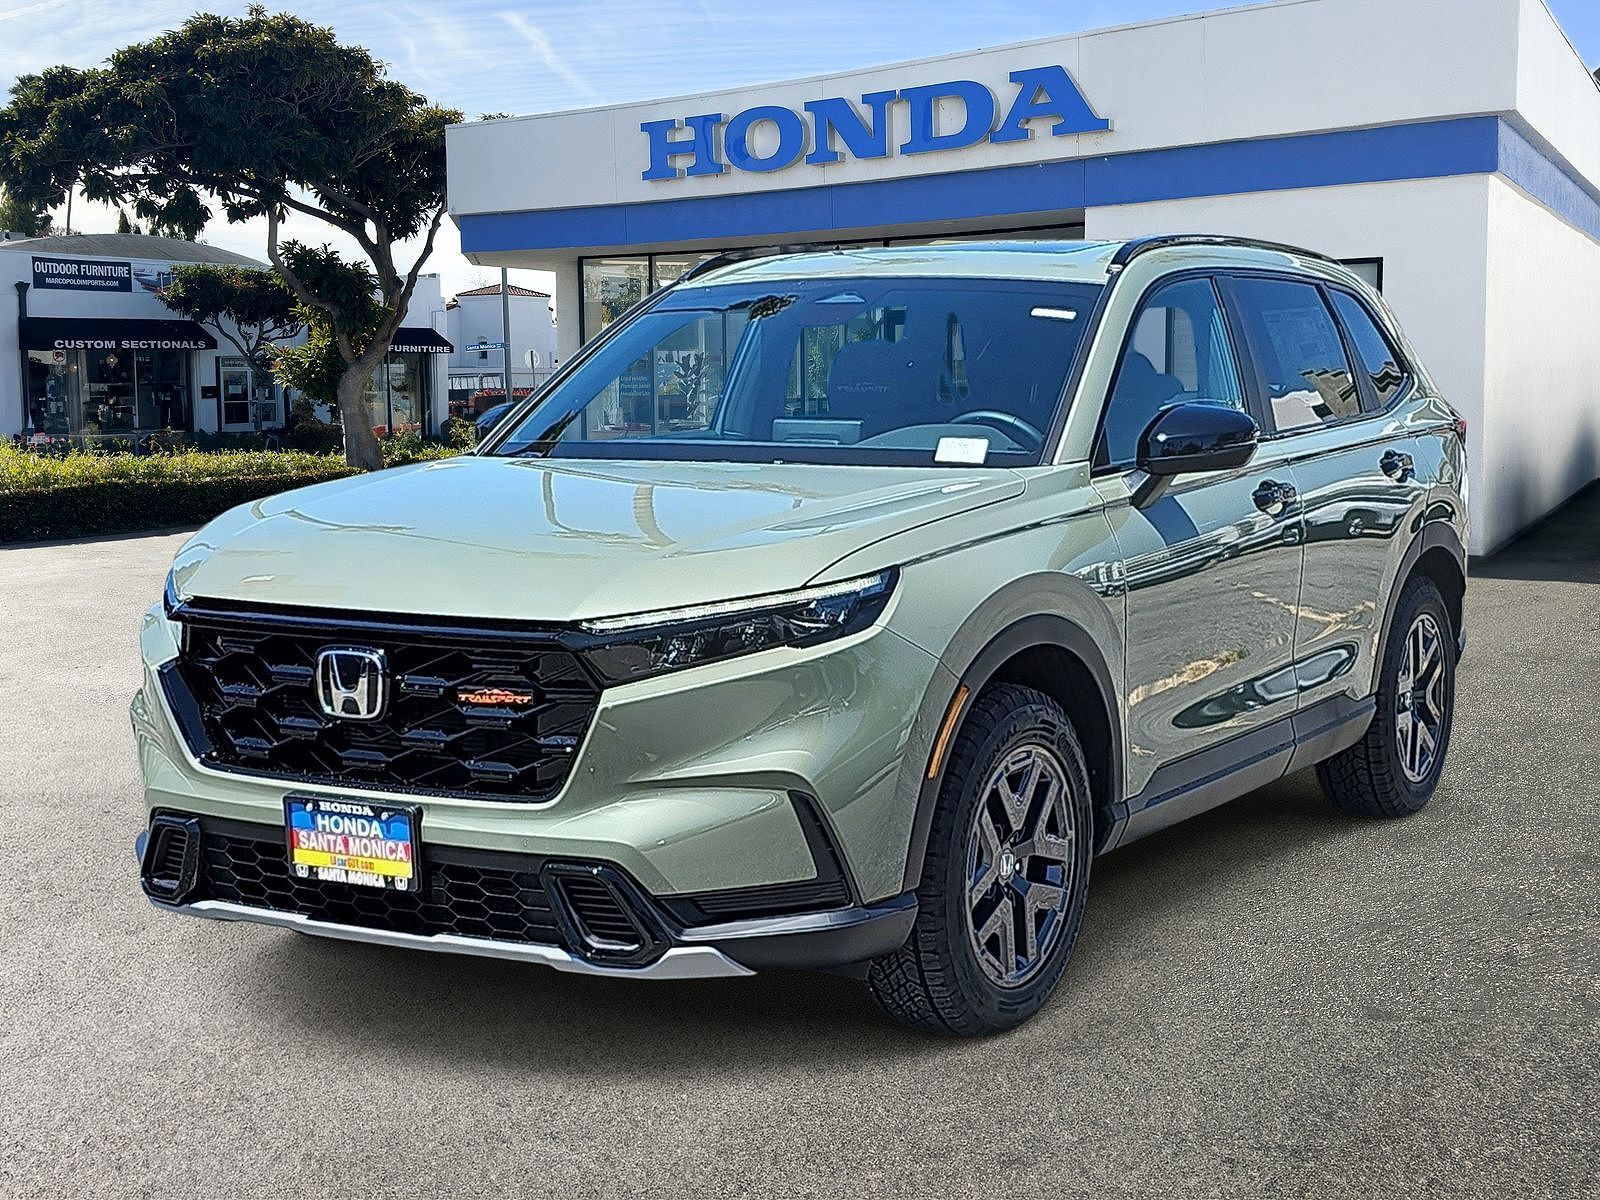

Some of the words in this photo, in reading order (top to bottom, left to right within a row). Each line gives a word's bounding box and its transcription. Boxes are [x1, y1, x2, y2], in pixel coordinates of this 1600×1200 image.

[641, 65, 1112, 183] HONDA
[34, 261, 79, 276] OUTDOOR
[80, 264, 130, 278] FURNITURE
[45, 276, 120, 287] MARCOPOLOIMPORTS.COM
[54, 339, 116, 350] CUSTOM
[121, 339, 207, 350] SECTIONALS
[389, 344, 451, 354] FURNITURE
[458, 693, 532, 704] TRAILSPORT
[319, 801, 374, 817] HONDA
[316, 814, 384, 839] HONDA
[298, 831, 347, 853] SANTA
[348, 836, 411, 862] MONICA
[318, 866, 347, 883] SANTA
[347, 870, 385, 889] MONICA
